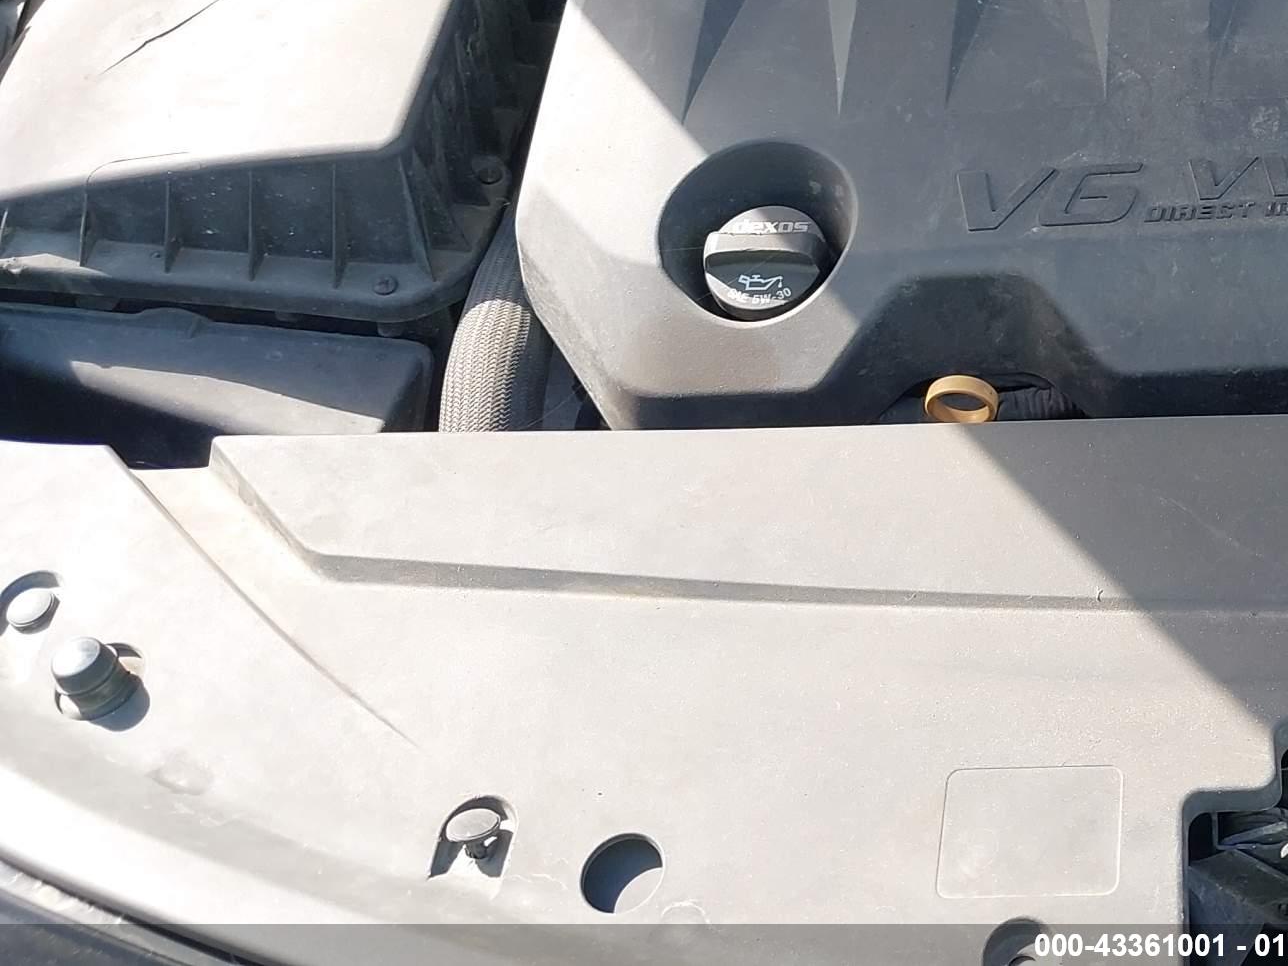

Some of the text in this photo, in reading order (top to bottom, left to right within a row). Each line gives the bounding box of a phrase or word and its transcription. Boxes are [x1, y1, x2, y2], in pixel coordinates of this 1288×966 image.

[957, 162, 1144, 232] V6
[1143, 201, 1255, 223] DIRECT
[731, 219, 811, 234] dexos
